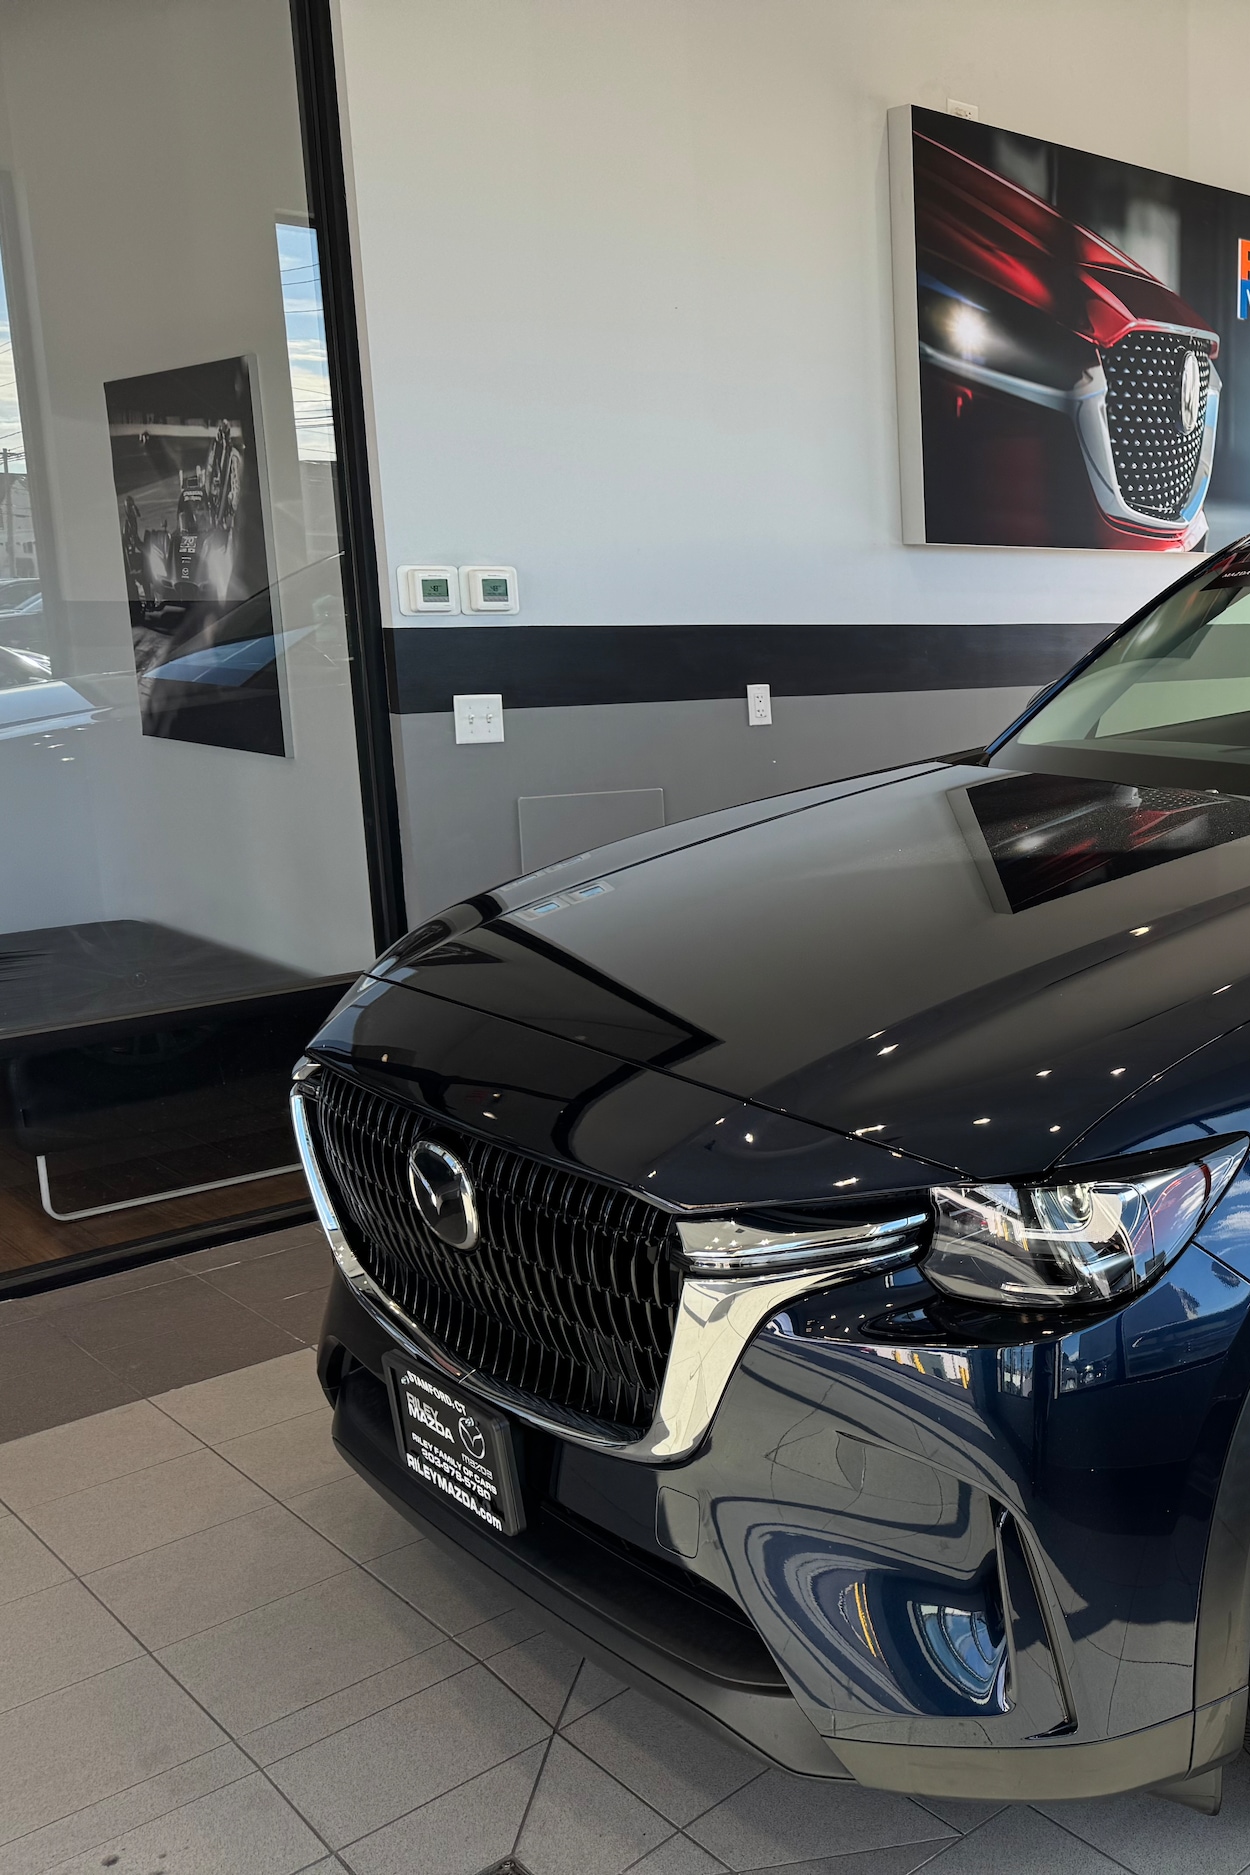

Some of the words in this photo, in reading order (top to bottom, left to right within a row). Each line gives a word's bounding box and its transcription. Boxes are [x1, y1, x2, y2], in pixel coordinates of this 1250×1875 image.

[1222, 570, 1250, 578] MAZDA
[406, 1391, 439, 1421] RILEY
[408, 1403, 455, 1443] MAZDA
[412, 1432, 433, 1451] RILEY
[434, 1446, 462, 1470] FAMILY
[463, 1466, 473, 1478] OF
[474, 1474, 497, 1495] CARS
[406, 1453, 502, 1531] RILEYMAZDA.com
